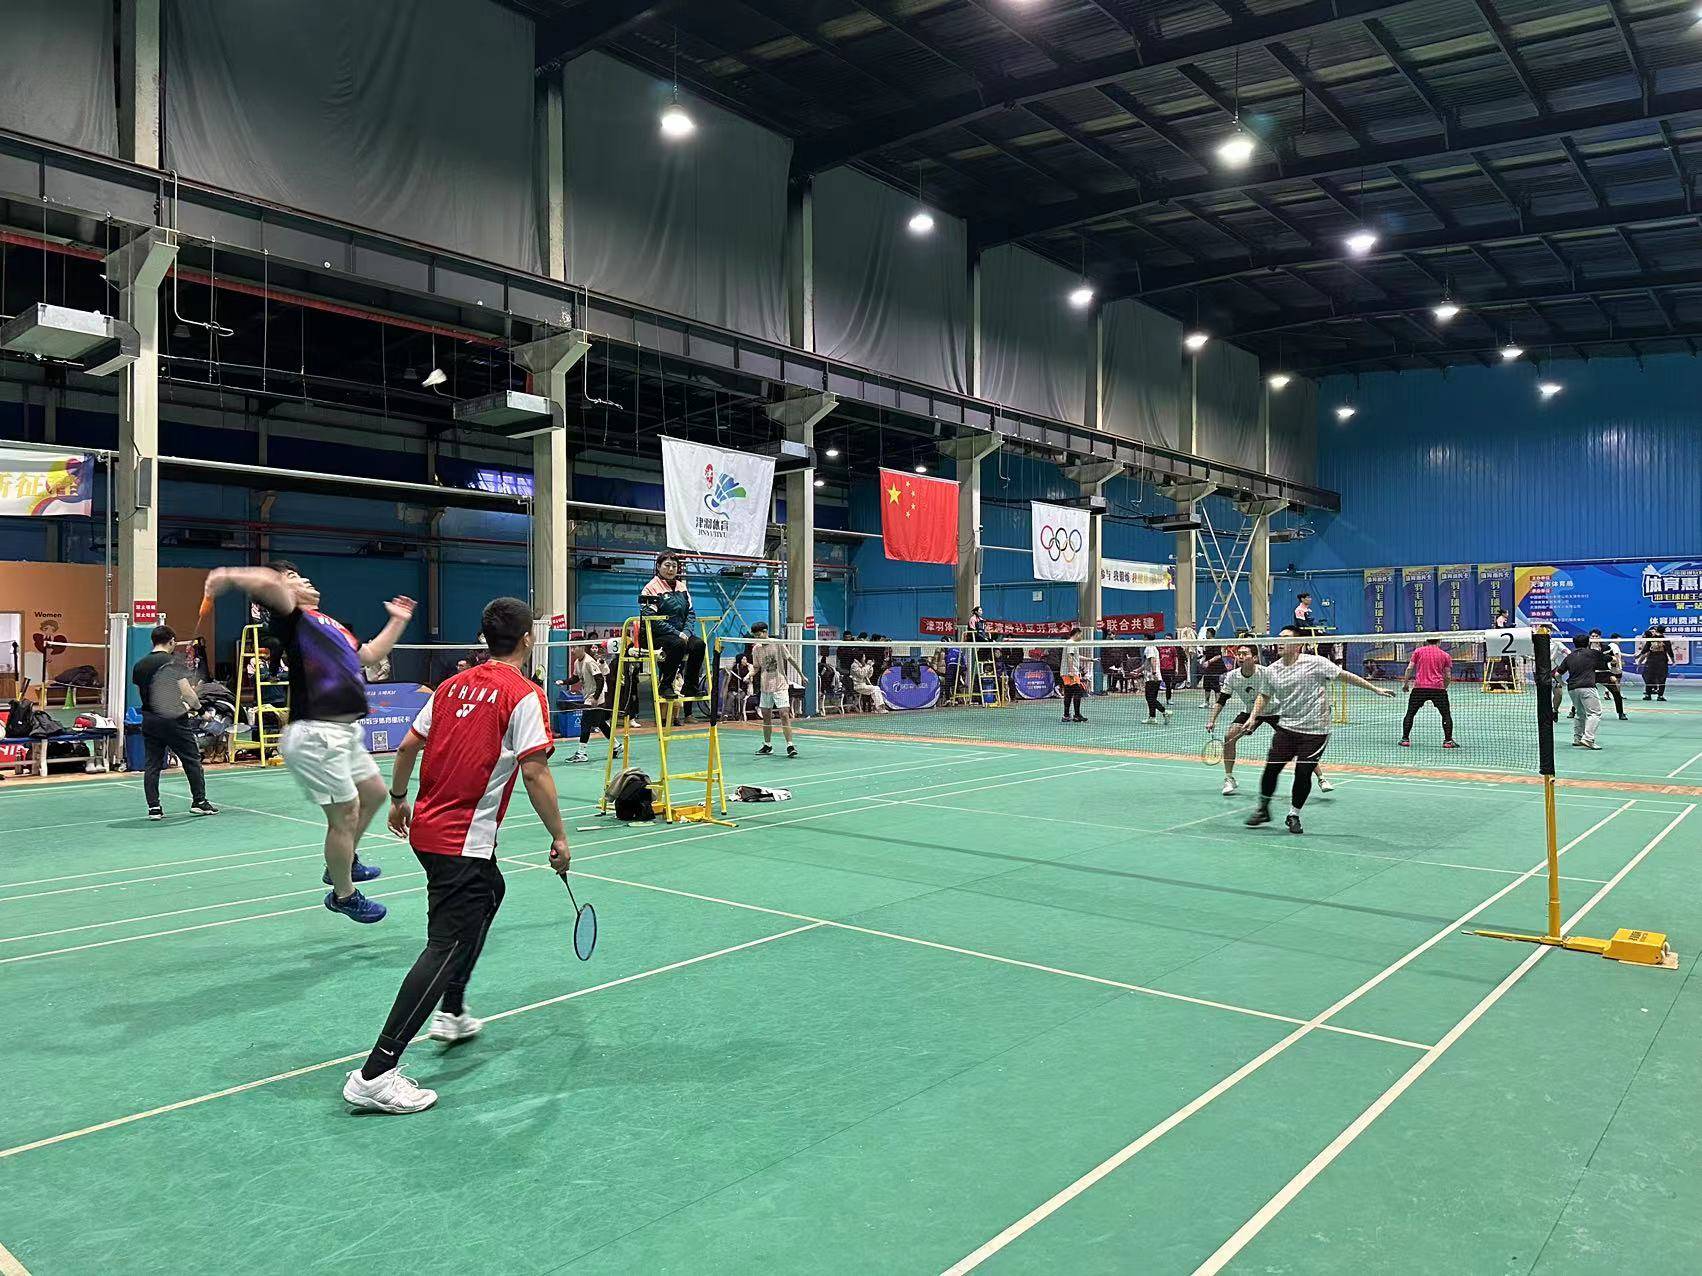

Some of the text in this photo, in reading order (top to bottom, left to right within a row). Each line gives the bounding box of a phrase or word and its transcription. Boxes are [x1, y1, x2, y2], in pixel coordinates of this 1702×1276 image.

[1645, 575, 1702, 593] 体育惠
[1106, 617, 1155, 631] 联合共建
[612, 640, 619, 653] 3
[1500, 632, 1517, 654] 2
[447, 683, 499, 704] CHINA
